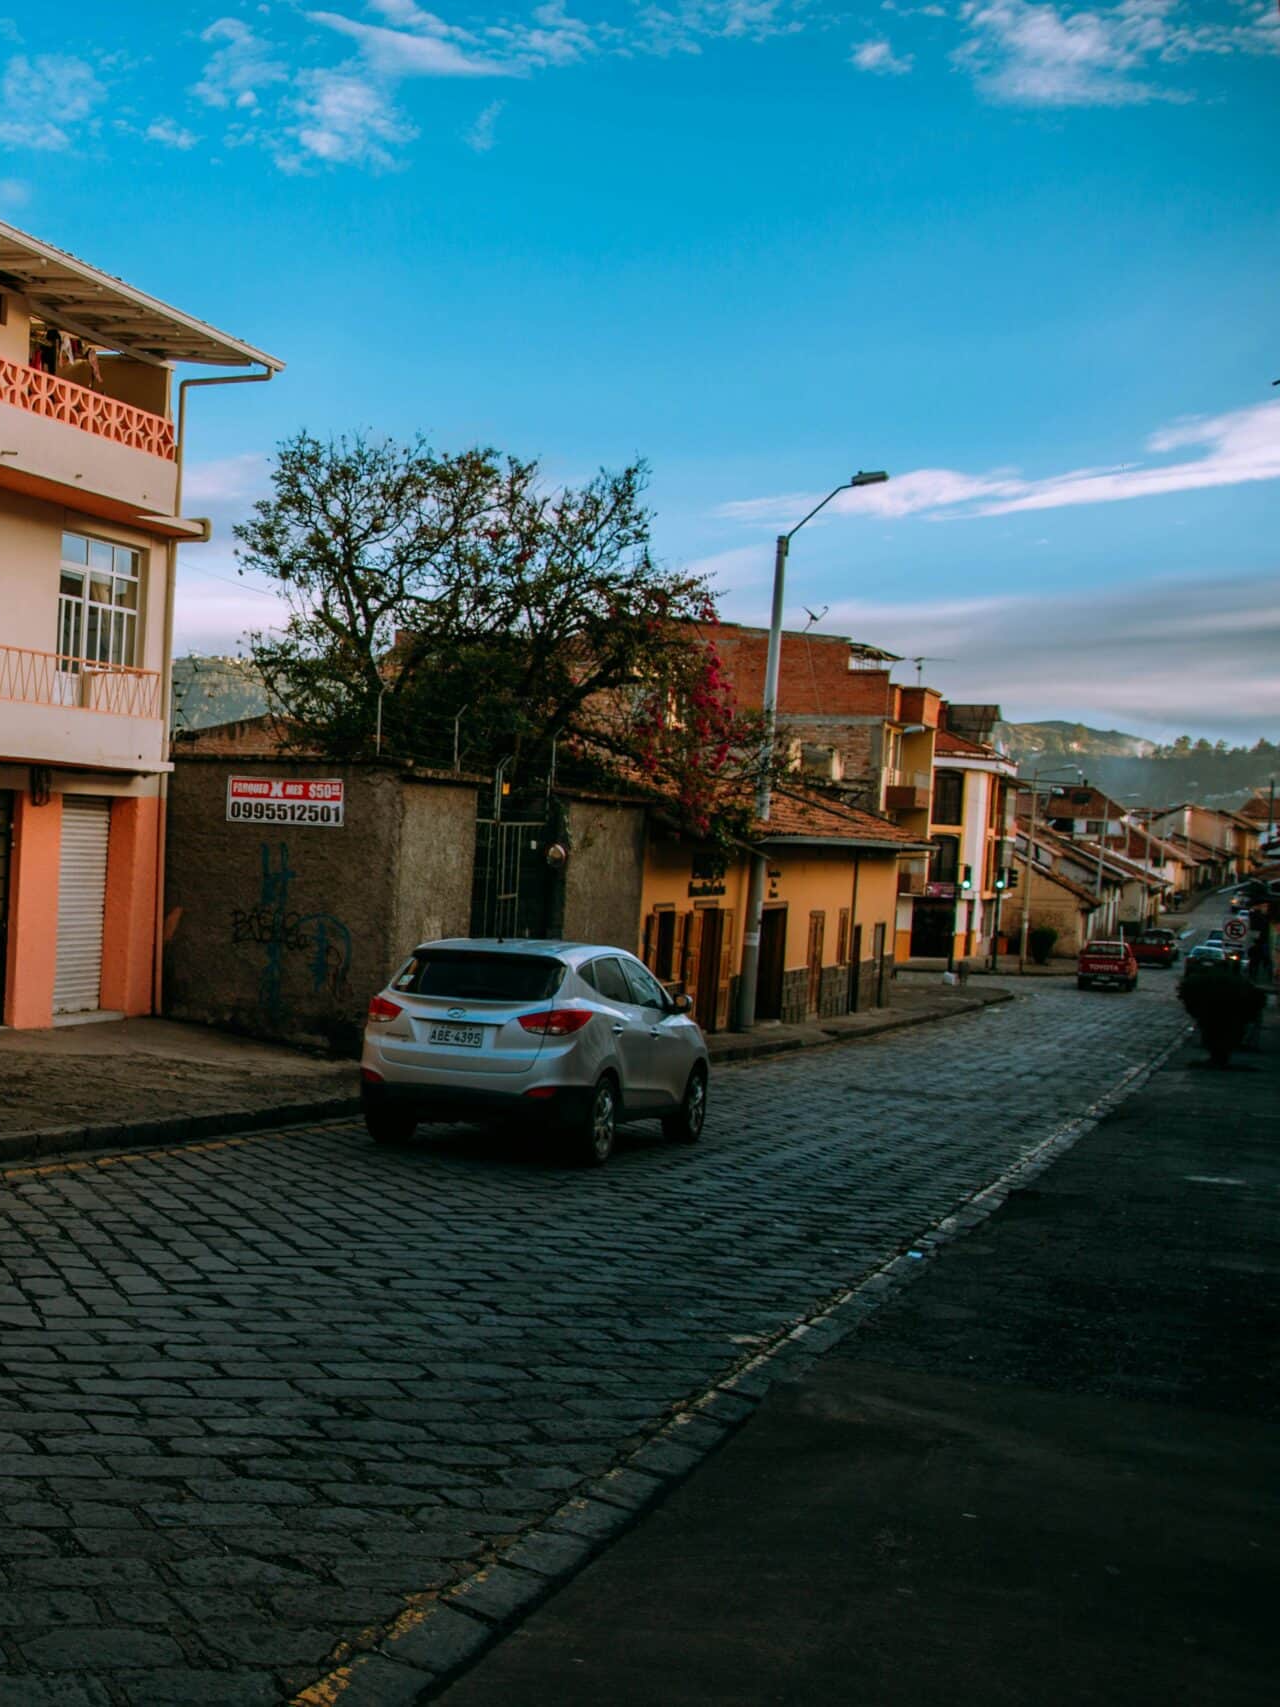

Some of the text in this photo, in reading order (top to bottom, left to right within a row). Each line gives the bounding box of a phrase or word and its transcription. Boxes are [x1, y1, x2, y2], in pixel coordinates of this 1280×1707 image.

[270, 781, 284, 798] X
[230, 800, 341, 823] 0995512501
[1088, 963, 1120, 973] TOYOTA
